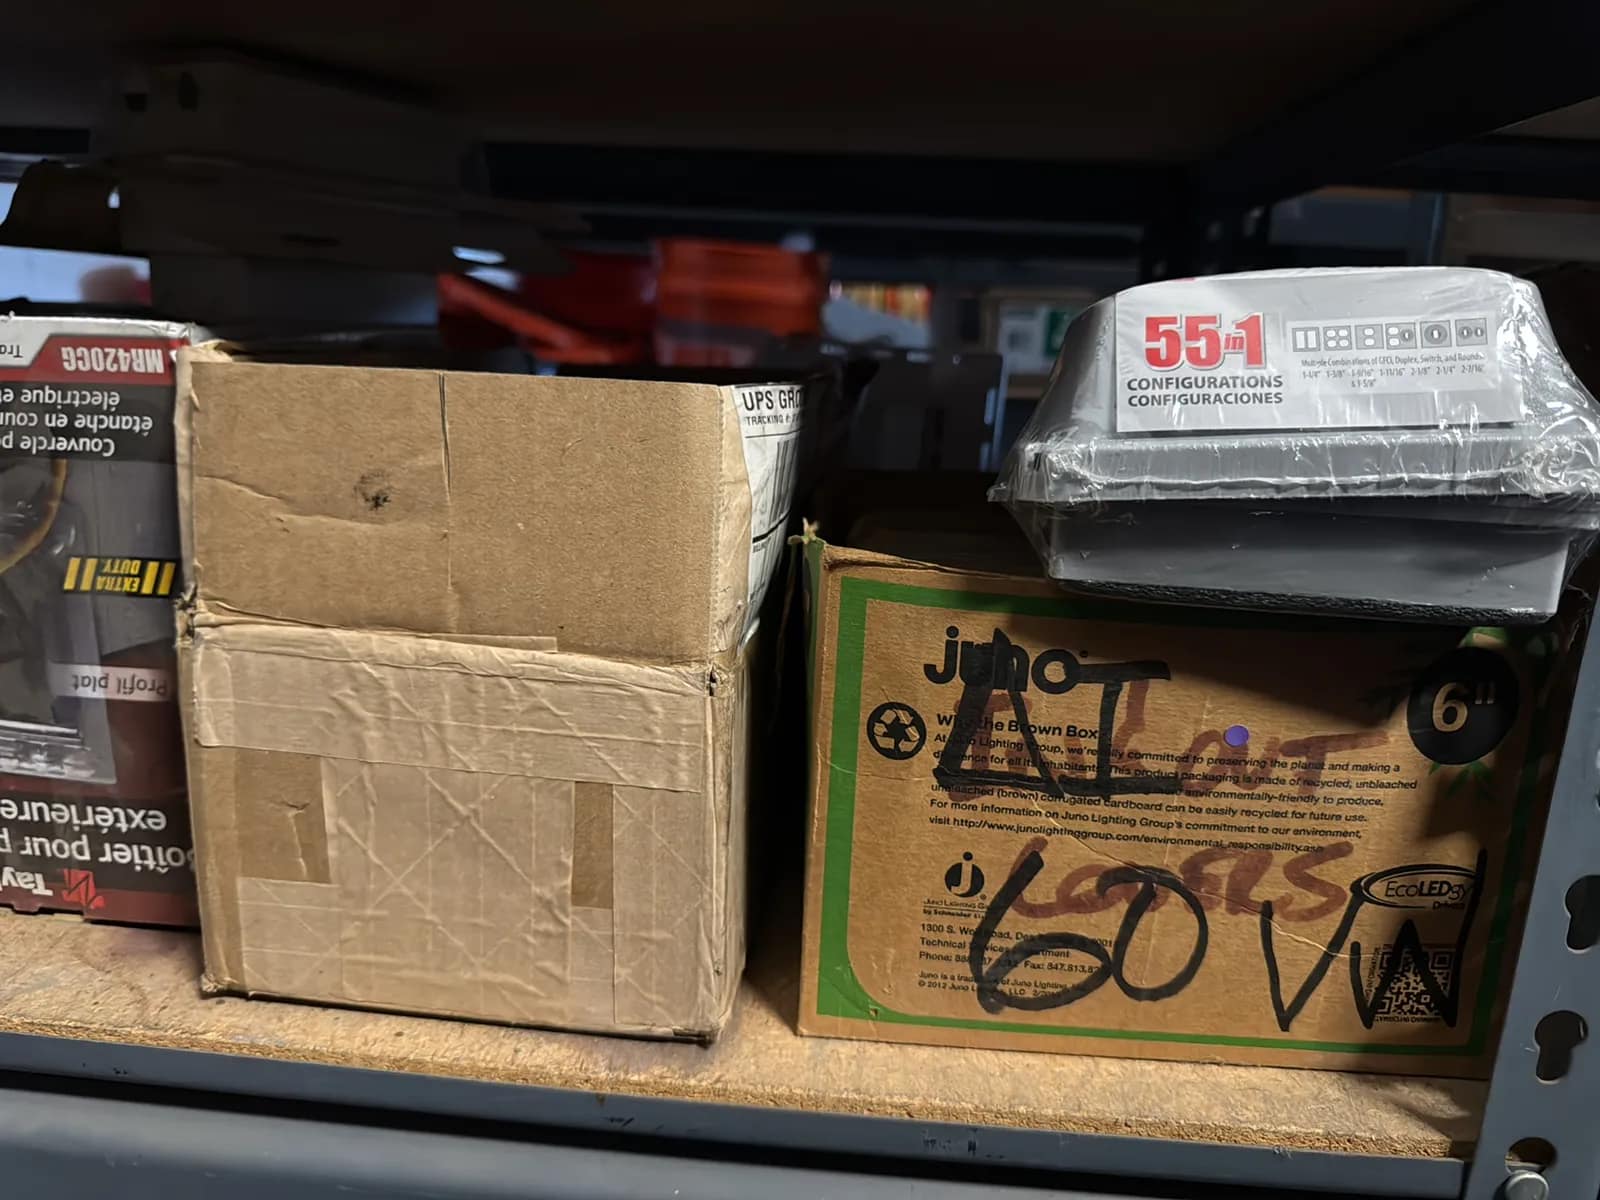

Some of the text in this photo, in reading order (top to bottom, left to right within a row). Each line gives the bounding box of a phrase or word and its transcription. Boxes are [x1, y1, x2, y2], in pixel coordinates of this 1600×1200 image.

[61, 346, 164, 374] MR420CG
[1127, 375, 1283, 391] CONFIGURATIONS
[20, 384, 120, 412] électrique
[742, 389, 774, 411] UPS
[1128, 391, 1283, 408] CONFIGURACIONES
[45, 413, 68, 428] en
[75, 414, 153, 437] étanche
[745, 414, 784, 426] TRACKING
[20, 435, 115, 457] Couvercle
[103, 559, 141, 574] DUTY
[96, 576, 140, 592] EXTRA
[72, 673, 168, 695] plat Profil
[977, 716, 1004, 731] he
[979, 738, 1024, 752] Lighting
[1033, 743, 1064, 756] roup,
[1127, 751, 1189, 763] committed
[1192, 755, 1204, 764] to
[1206, 756, 1267, 769] preserving
[1270, 759, 1287, 769] the
[1290, 760, 1325, 772] planet
[1328, 763, 1349, 772] and
[1352, 764, 1390, 775] making
[932, 750, 988, 763] dence
[990, 754, 1006, 765] for
[1043, 759, 1099, 773] nhabitant
[1134, 768, 1178, 780] product
[1181, 771, 1240, 784] packaging
[1243, 775, 1252, 784] is
[1255, 775, 1286, 786] made
[1289, 776, 1301, 786] of
[1356, 779, 1417, 790] unbleached
[997, 787, 1038, 801] (brown)
[1041, 792, 1101, 806] corrugated
[1103, 799, 1162, 812] cardboard
[1165, 804, 1185, 813] can
[1188, 804, 1202, 814] be
[1205, 806, 1237, 817] easily
[1240, 808, 1288, 820] recycled
[1291, 809, 1306, 819] for
[1309, 811, 1342, 822] future
[1345, 814, 1368, 822] use.
[1323, 793, 1334, 804] to
[1337, 794, 1384, 806] produce.
[0, 799, 168, 834] extérieure
[929, 815, 950, 826] visit
[930, 798, 1363, 840] For more information on Juno Lighting Group's commitment to our environment,
[20, 834, 91, 861] pour
[0, 866, 54, 896] Tay
[920, 937, 966, 949] Technical
[922, 923, 944, 933] 1300
[946, 925, 956, 934] S.
[992, 931, 1013, 941] oad,
[920, 951, 953, 962] Phone:
[1024, 960, 1045, 971] Fax:
